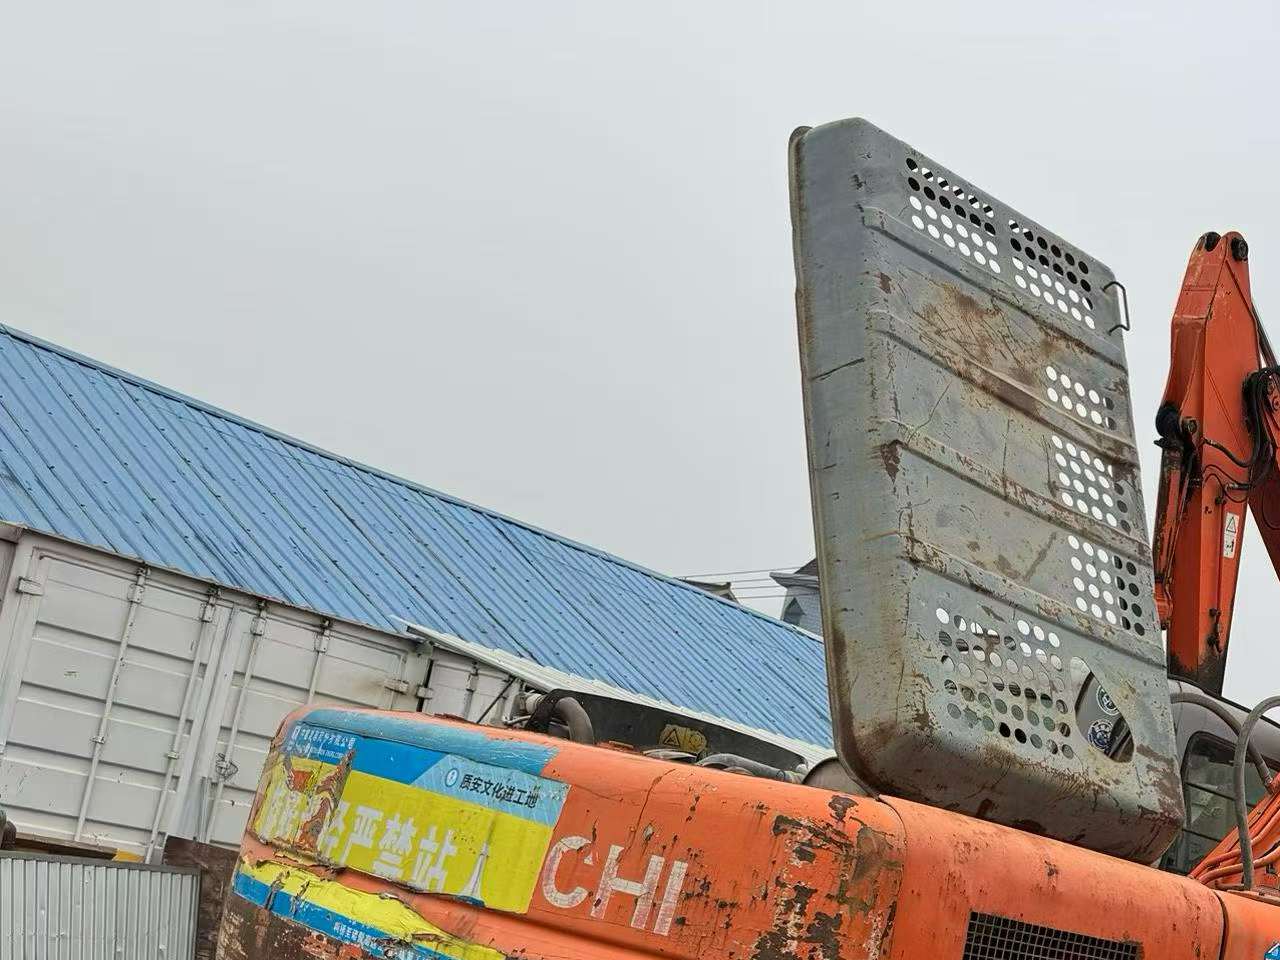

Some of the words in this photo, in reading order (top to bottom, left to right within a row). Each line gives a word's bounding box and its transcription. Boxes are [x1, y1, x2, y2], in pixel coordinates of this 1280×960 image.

[459, 773, 540, 808] 质安文化进工地
[542, 835, 689, 936] CHI
